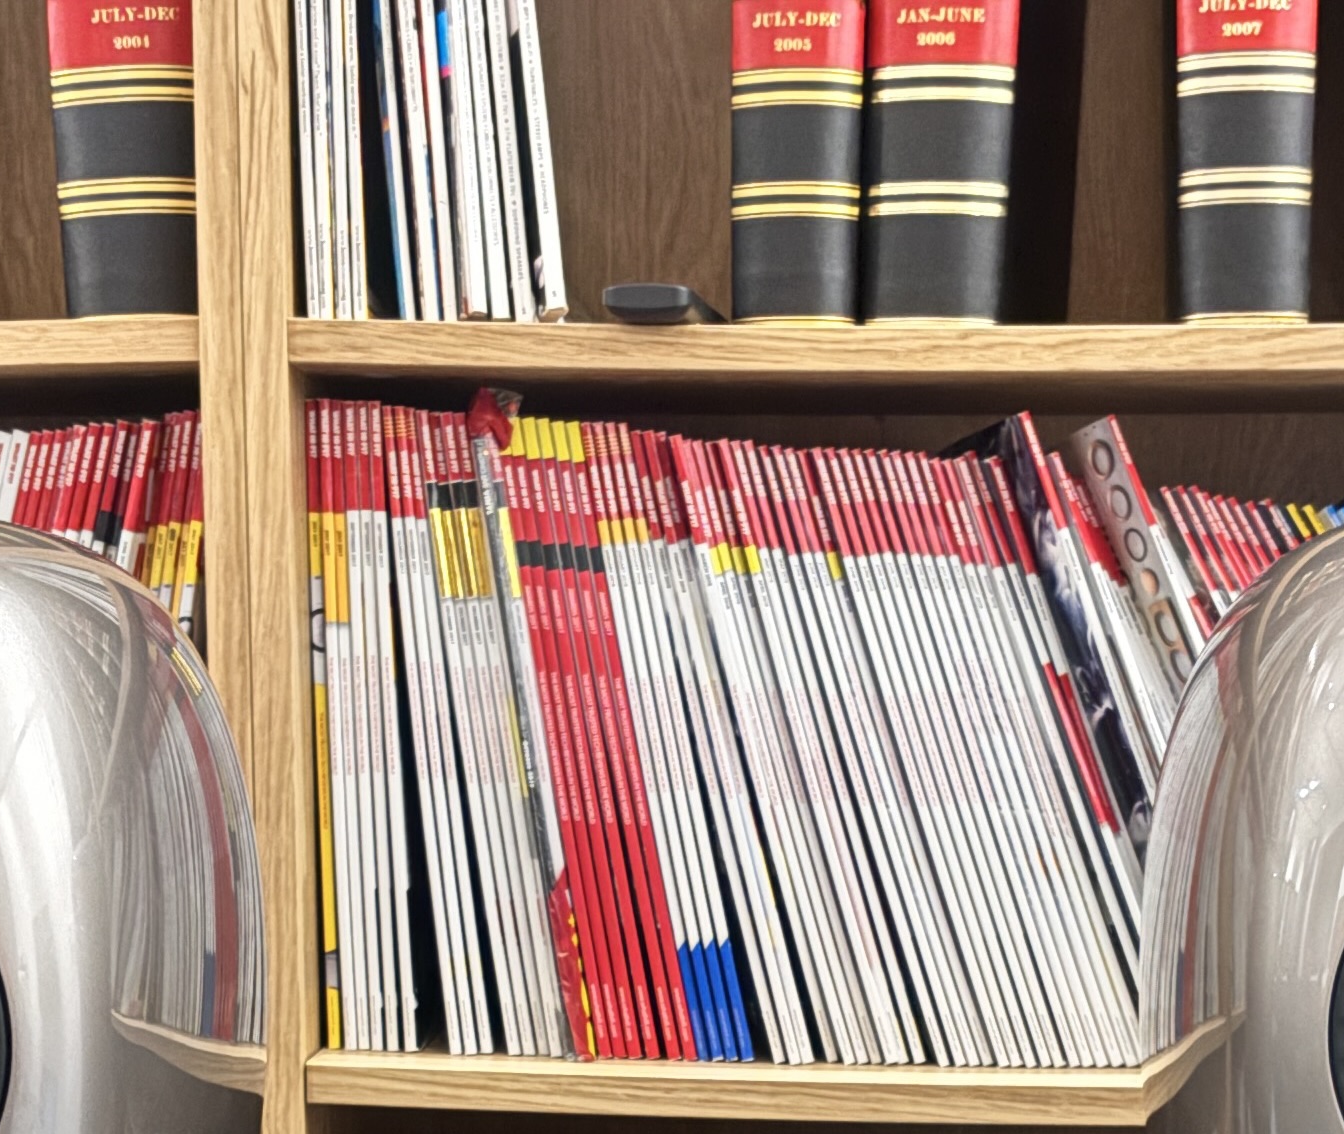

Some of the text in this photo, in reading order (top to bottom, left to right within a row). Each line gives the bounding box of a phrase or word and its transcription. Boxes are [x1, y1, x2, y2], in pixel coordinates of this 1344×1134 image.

[91, 6, 180, 24] JULY-DEC
[752, 11, 842, 28] JULY-DEC
[896, 7, 986, 24] JAN-JUNE
[1221, 21, 1263, 38] 2007
[916, 31, 955, 46] 2006
